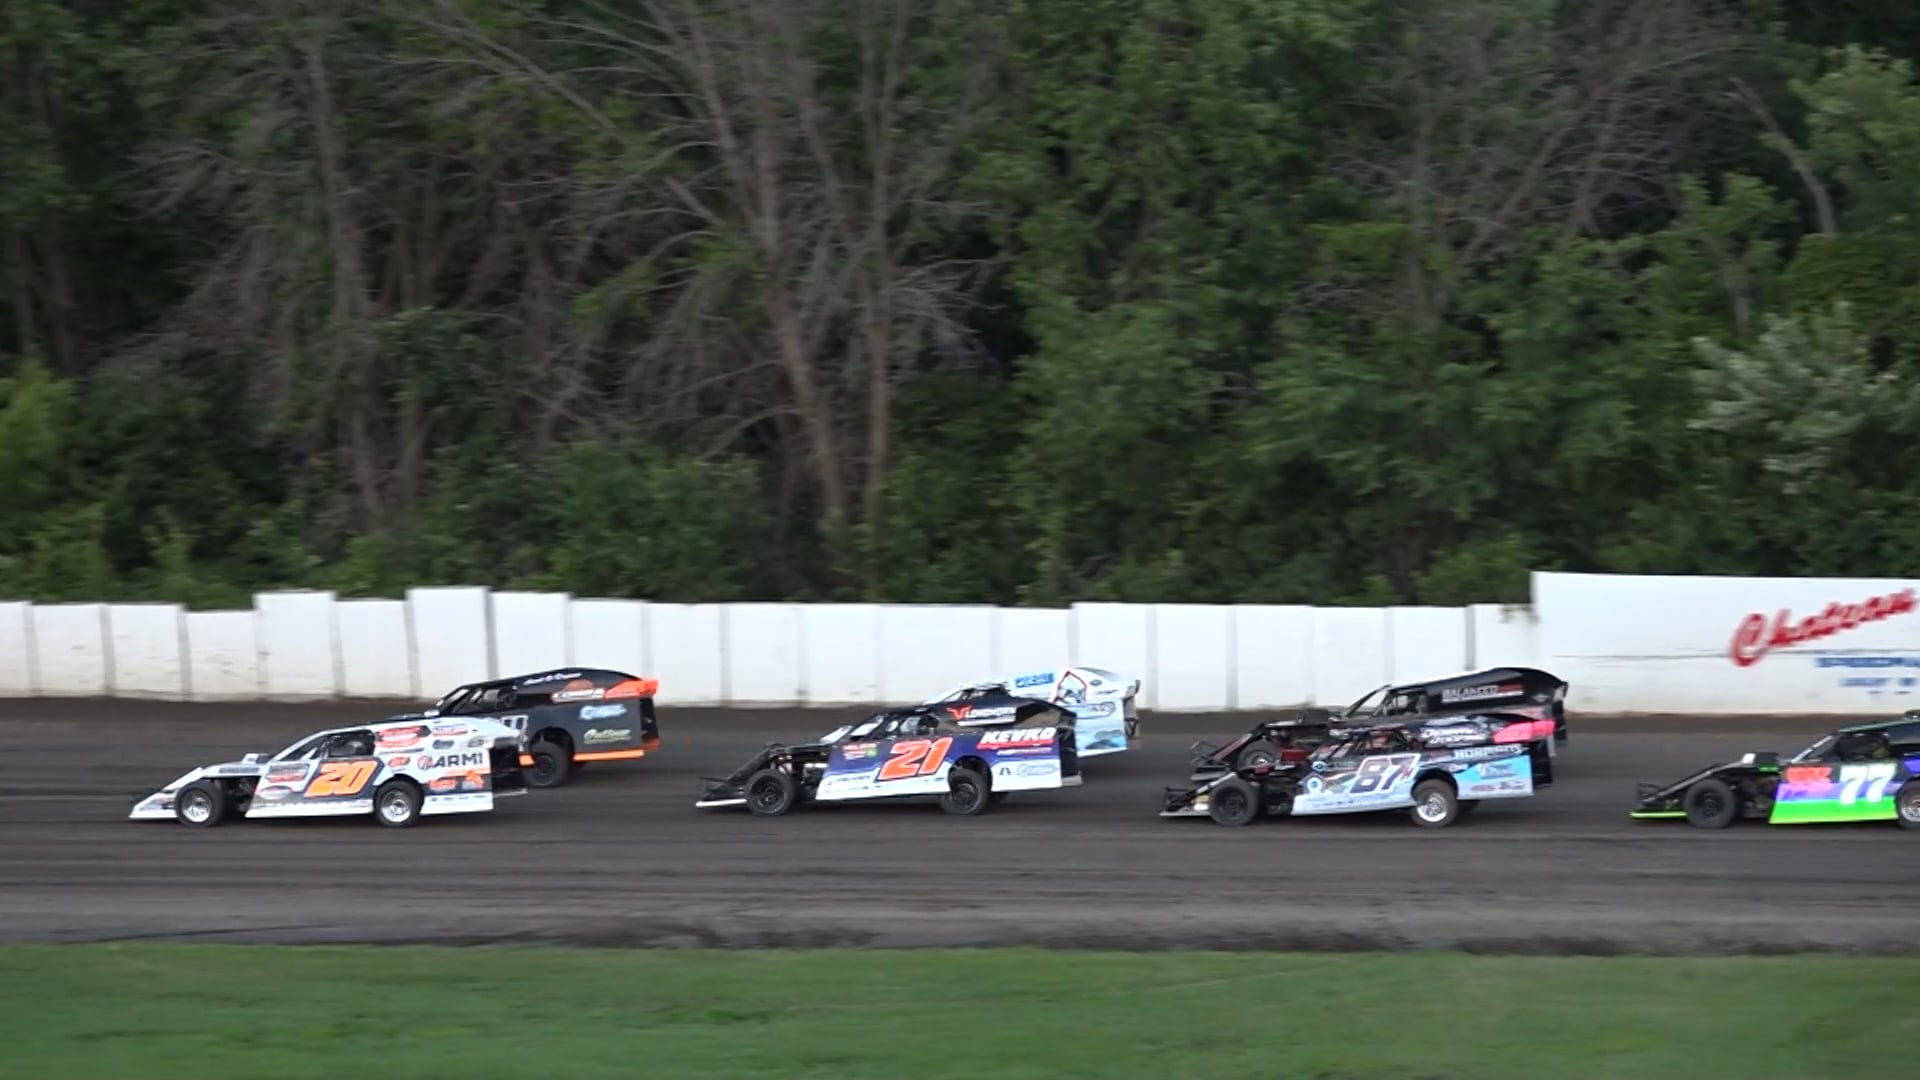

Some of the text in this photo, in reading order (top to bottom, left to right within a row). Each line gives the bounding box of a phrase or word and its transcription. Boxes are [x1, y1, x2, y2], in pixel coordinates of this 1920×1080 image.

[979, 727, 1057, 745] KEVKO
[304, 761, 380, 797] 20
[877, 735, 955, 781] 21
[1346, 753, 1421, 796] 87
[1838, 763, 1898, 806] 77
